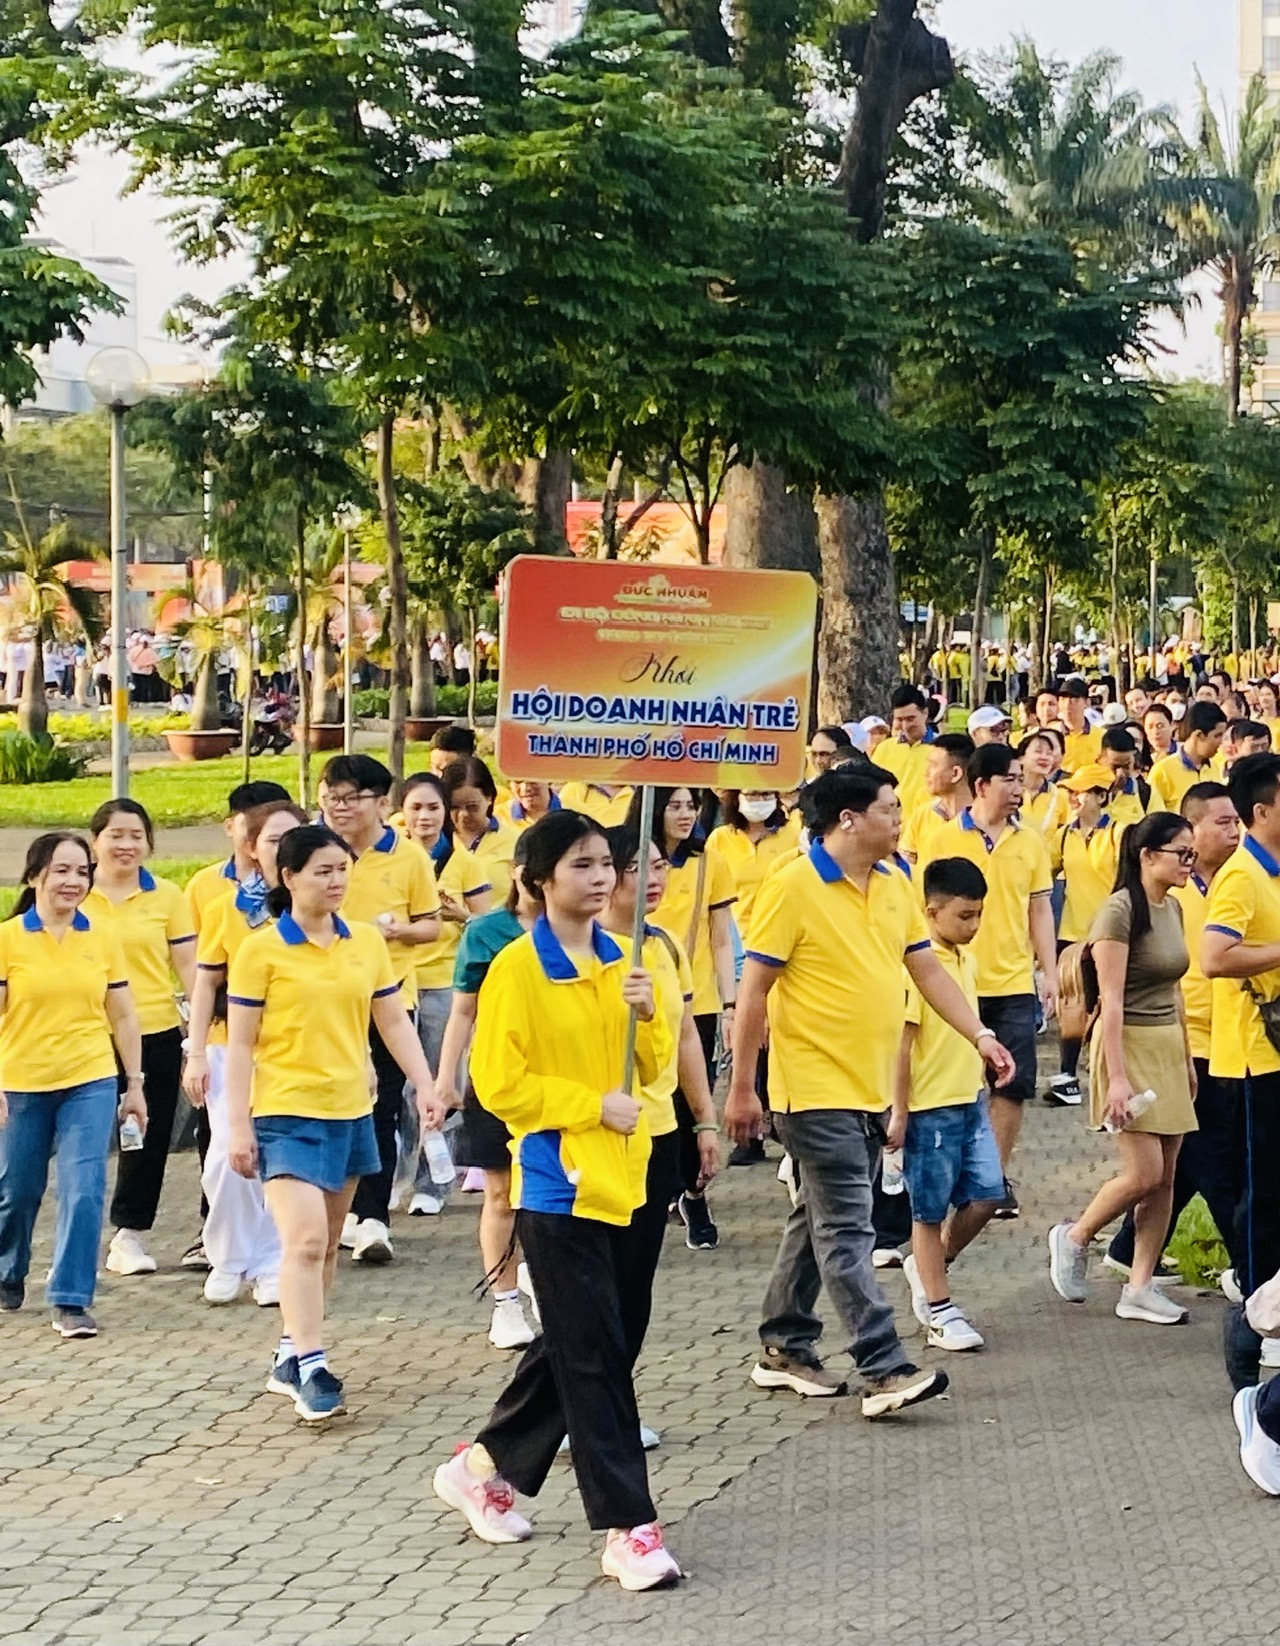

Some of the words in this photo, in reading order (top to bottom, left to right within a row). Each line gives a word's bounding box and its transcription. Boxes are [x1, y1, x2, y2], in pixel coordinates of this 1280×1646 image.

[511, 687, 561, 722] HỘI
[568, 697, 665, 722] DOANH
[672, 697, 746, 726] NHÂN
[752, 698, 798, 728] TRẺ
[528, 731, 597, 755] THÀNH
[603, 733, 651, 757] PHỐ
[689, 736, 725, 760] CHÍ
[725, 744, 777, 762] MINH
